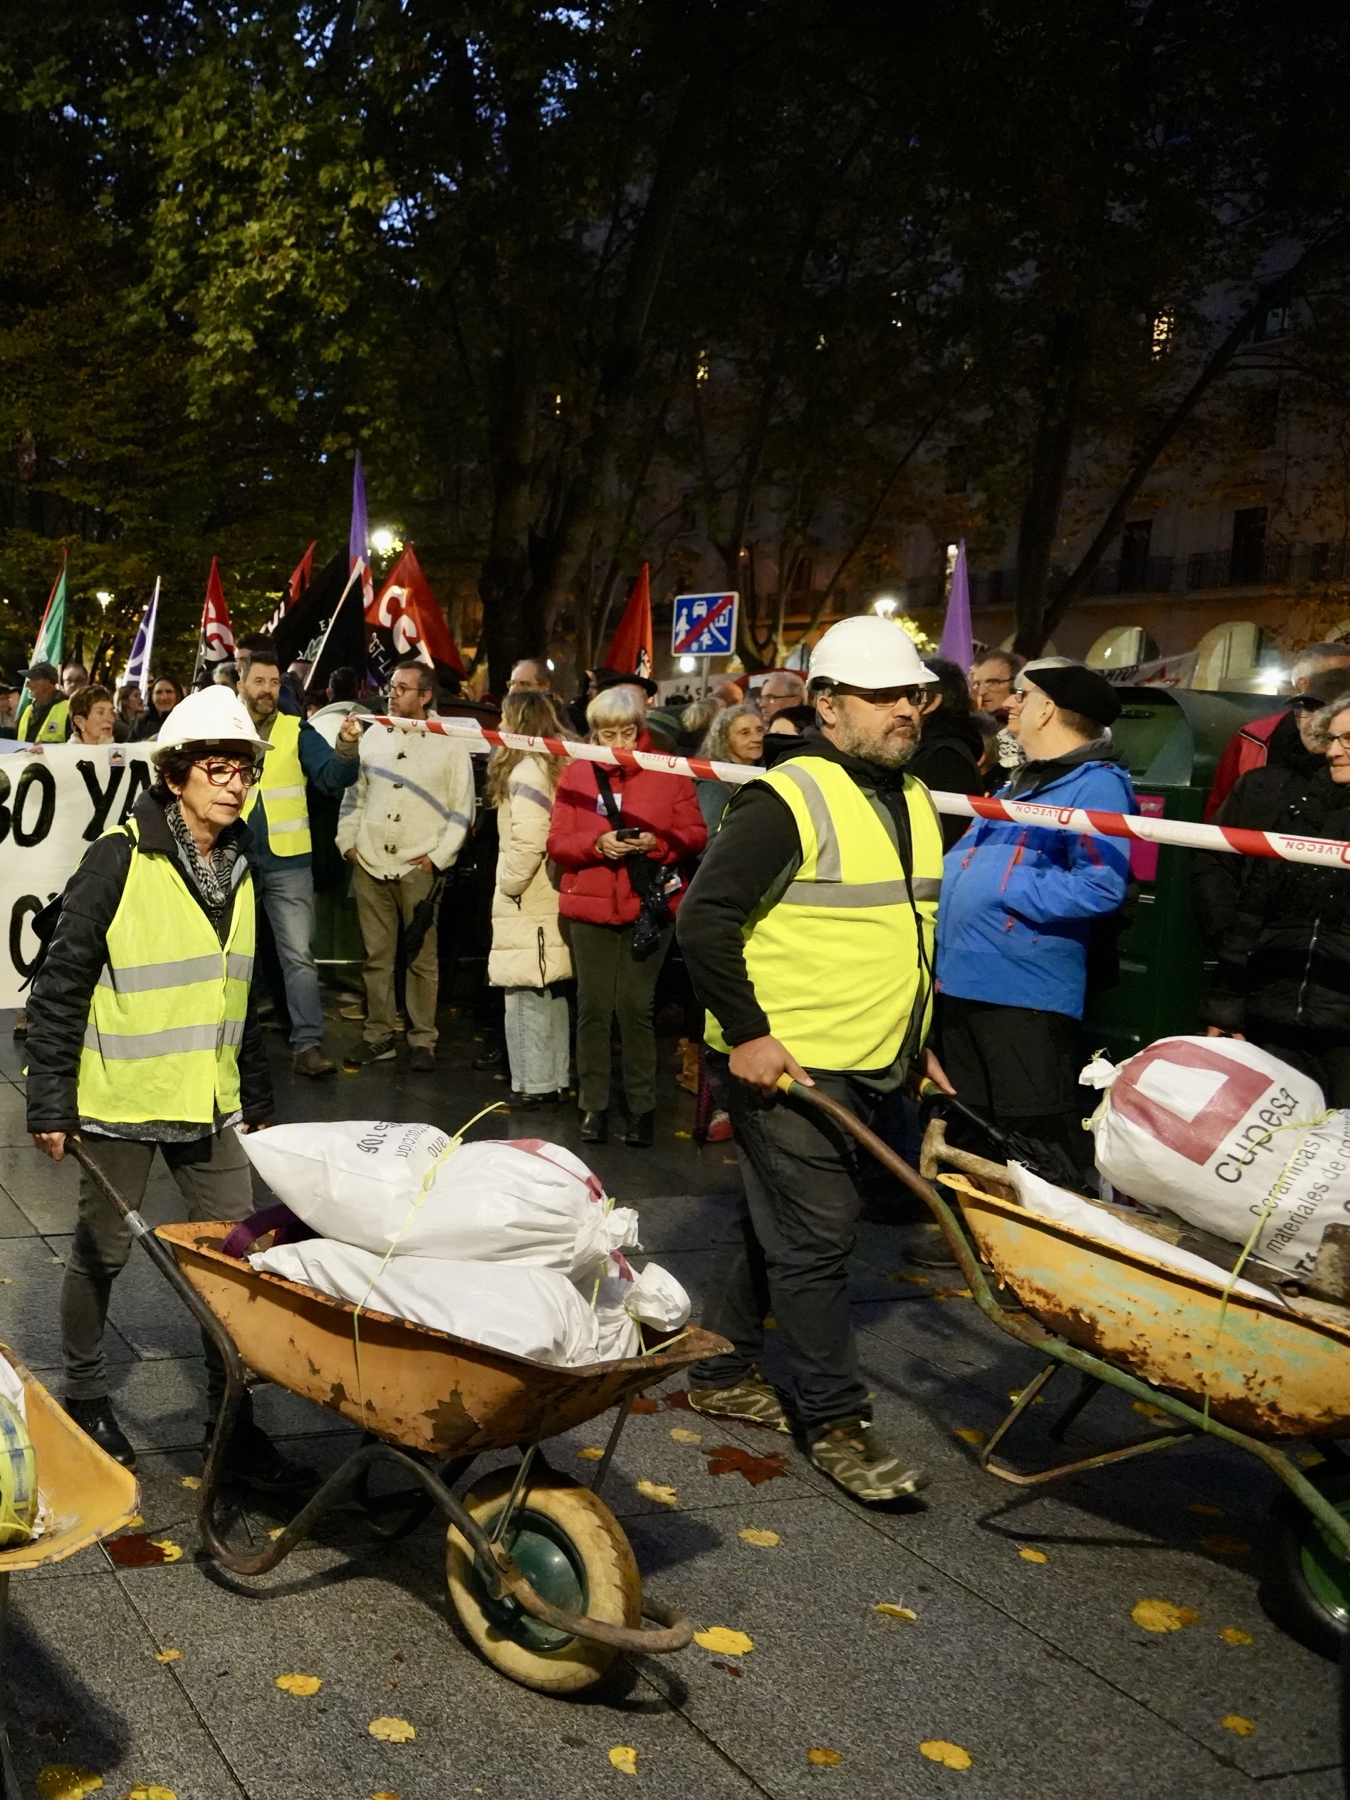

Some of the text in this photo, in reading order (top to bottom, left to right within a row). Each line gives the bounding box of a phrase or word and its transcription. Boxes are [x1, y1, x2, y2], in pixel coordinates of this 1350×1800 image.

[356, 1133, 388, 1155] 106
[1214, 1087, 1300, 1184] cupesa
[1249, 1139, 1321, 1219] Ceramicas
[1265, 1181, 1330, 1254] materiales
[1321, 1161, 1346, 1181] de
